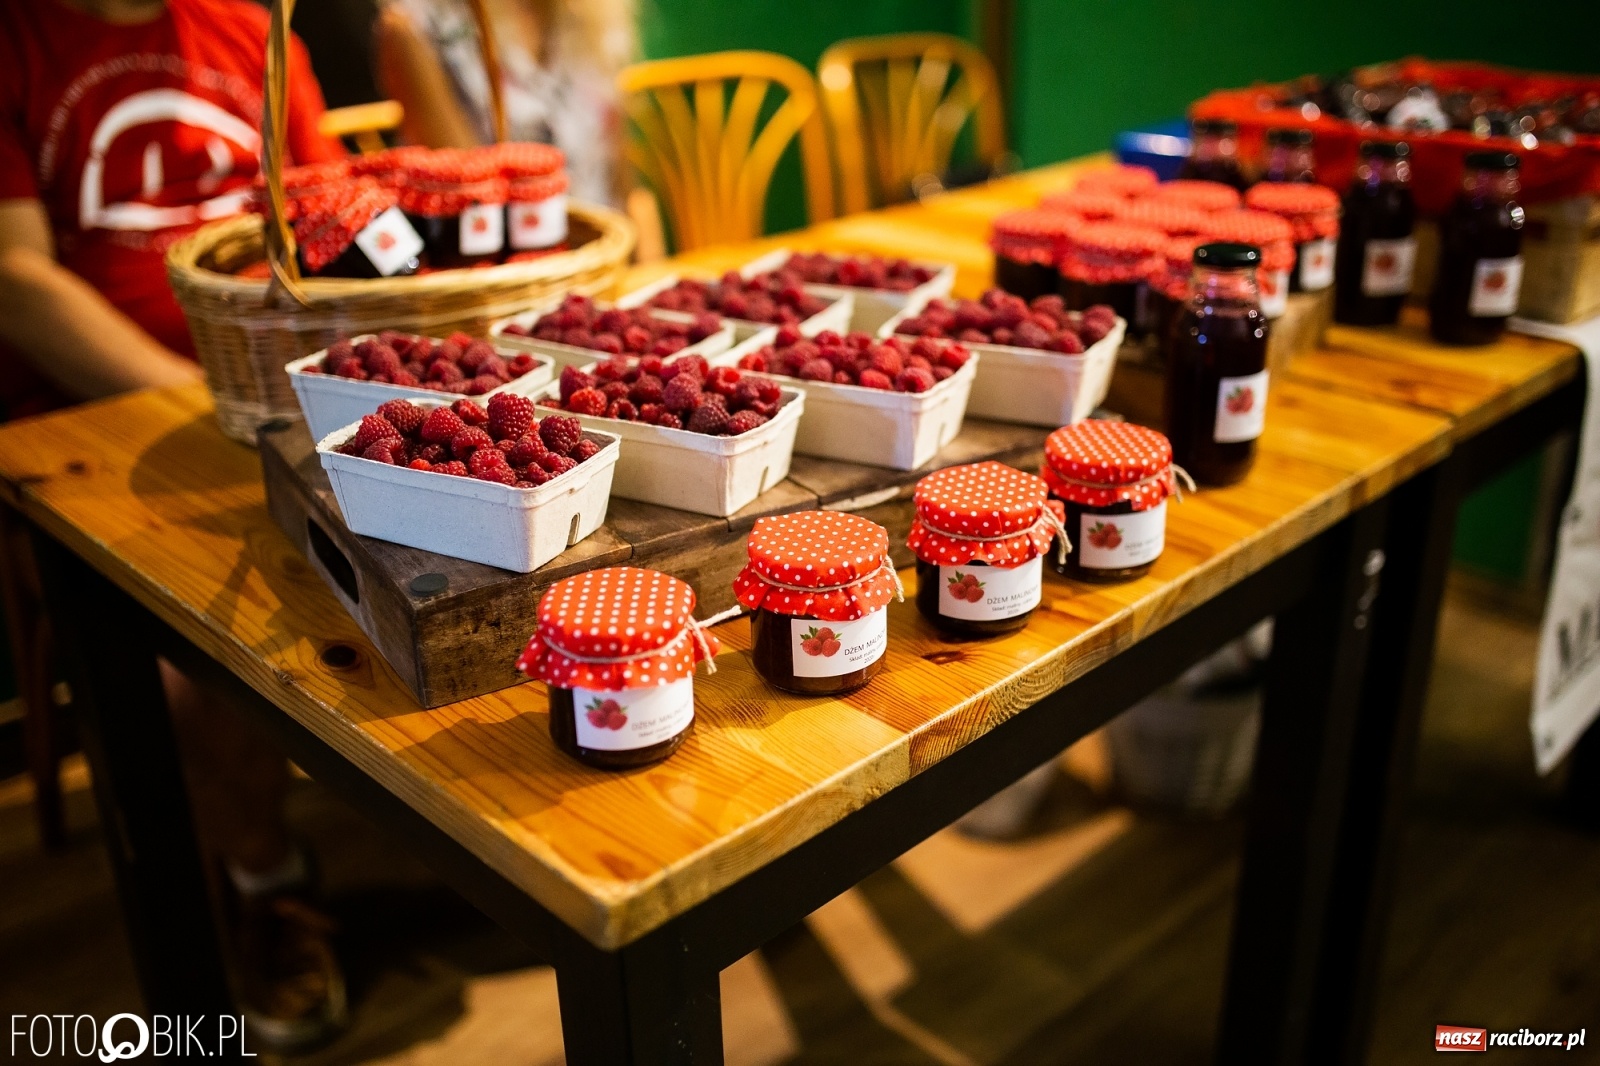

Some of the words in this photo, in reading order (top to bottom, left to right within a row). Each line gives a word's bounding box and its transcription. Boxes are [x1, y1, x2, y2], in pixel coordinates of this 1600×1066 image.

[987, 596, 1008, 605] DŻEM
[844, 644, 864, 656] DŻEM
[866, 629, 885, 648] MALIN
